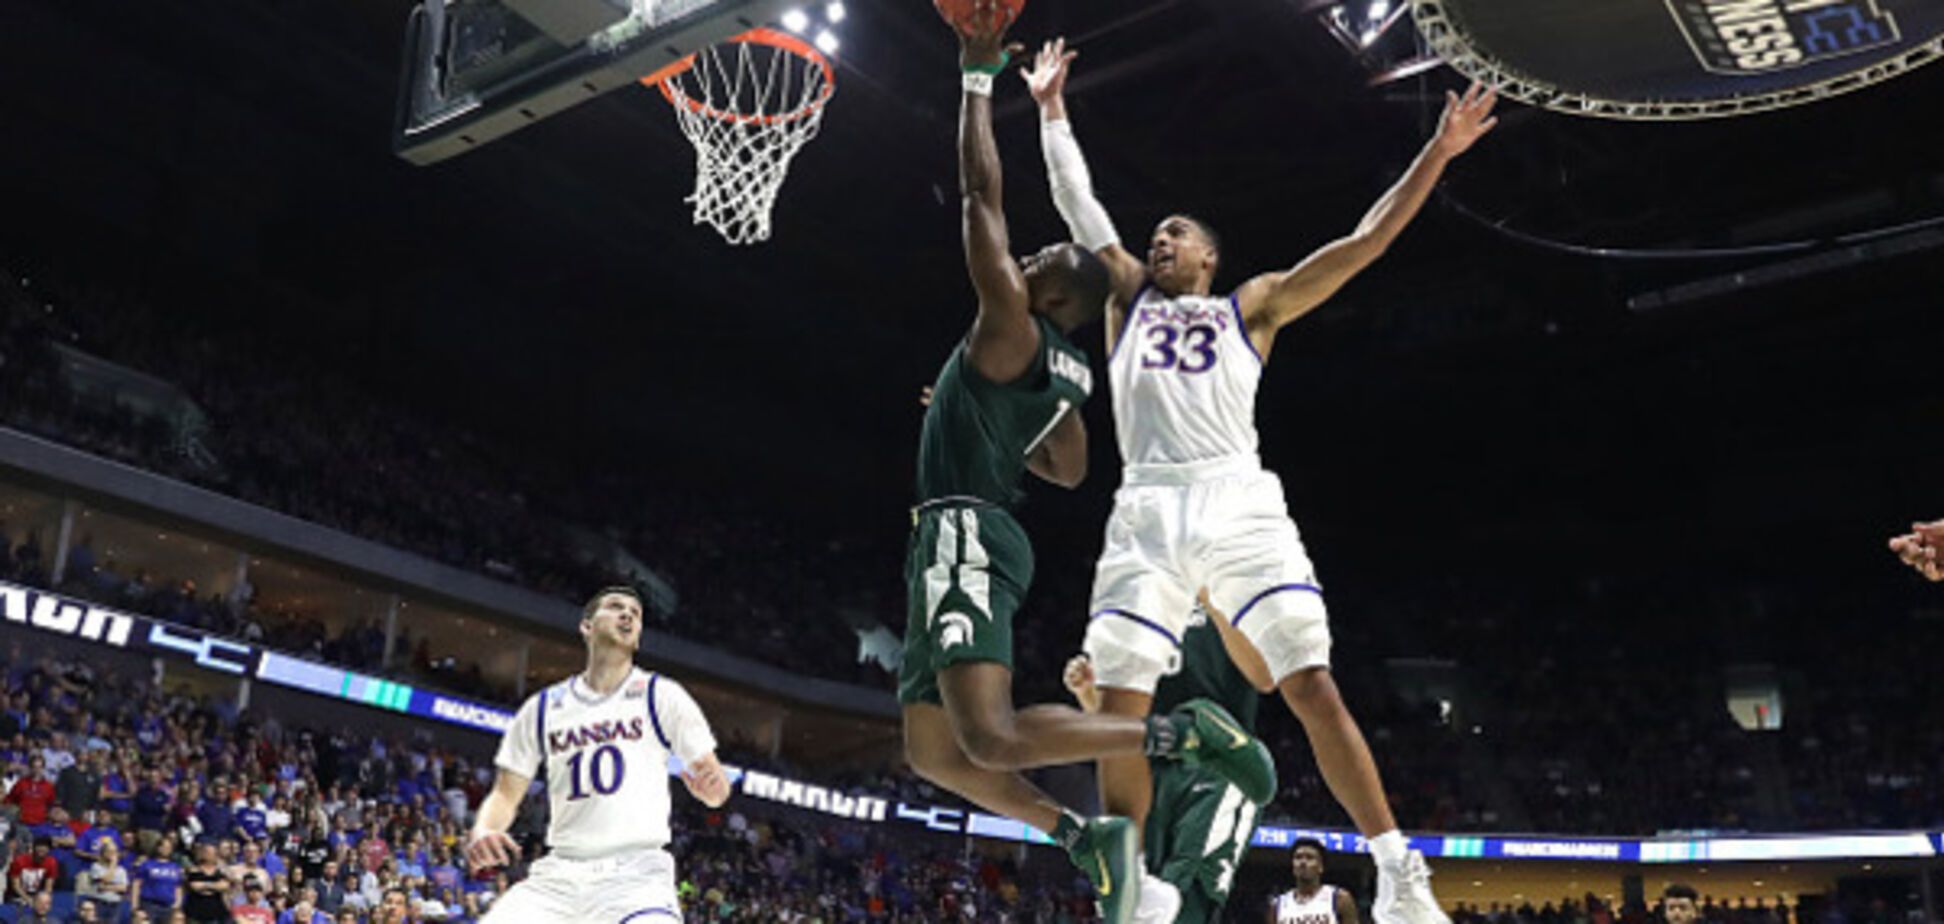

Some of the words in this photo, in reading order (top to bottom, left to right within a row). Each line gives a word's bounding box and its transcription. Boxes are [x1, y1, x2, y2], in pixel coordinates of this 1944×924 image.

[1142, 323, 1217, 375] 33
[548, 717, 643, 755] KANSAS
[566, 744, 625, 801] 10
